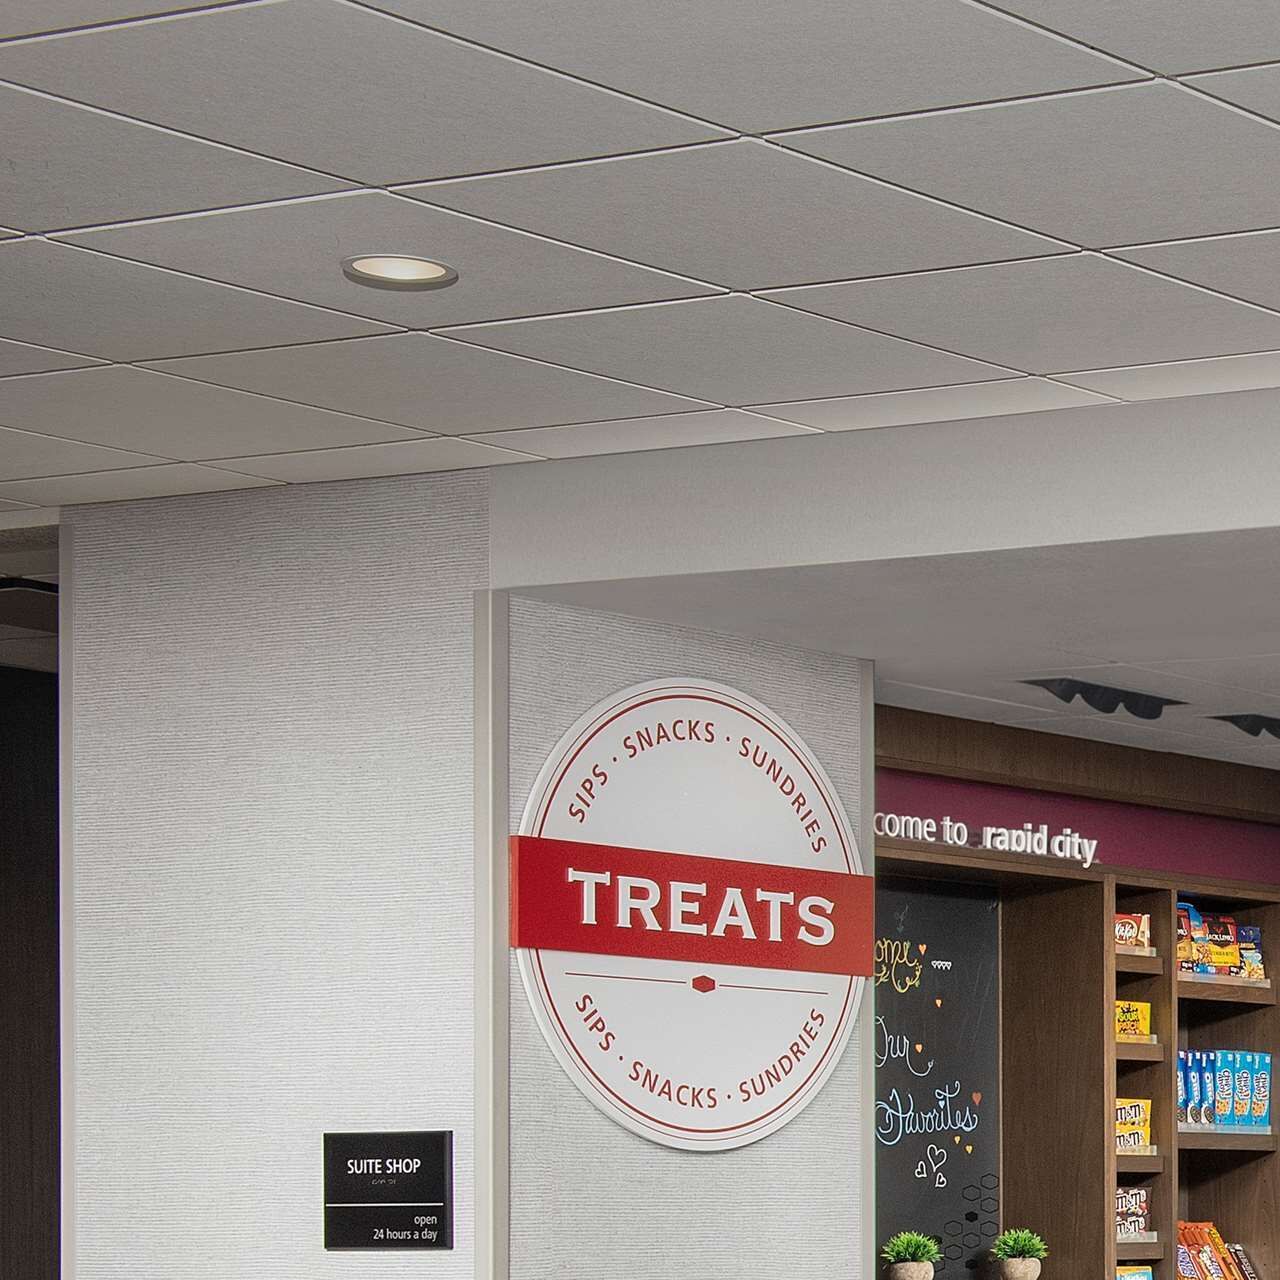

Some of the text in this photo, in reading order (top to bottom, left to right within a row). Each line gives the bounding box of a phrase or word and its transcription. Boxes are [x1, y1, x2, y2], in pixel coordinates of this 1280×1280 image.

[568, 719, 827, 853] SIPS SNACKS SUNDRIES
[940, 815, 968, 846] to
[567, 867, 836, 947] TREATS
[575, 994, 826, 1109] SIPS SNACKS SUNDRIES
[875, 1081, 978, 1145] Favorites
[347, 1158, 421, 1174] SUITE SHOP
[373, 1227, 438, 1242] 24 hours a day
[414, 1215, 438, 1227] open
